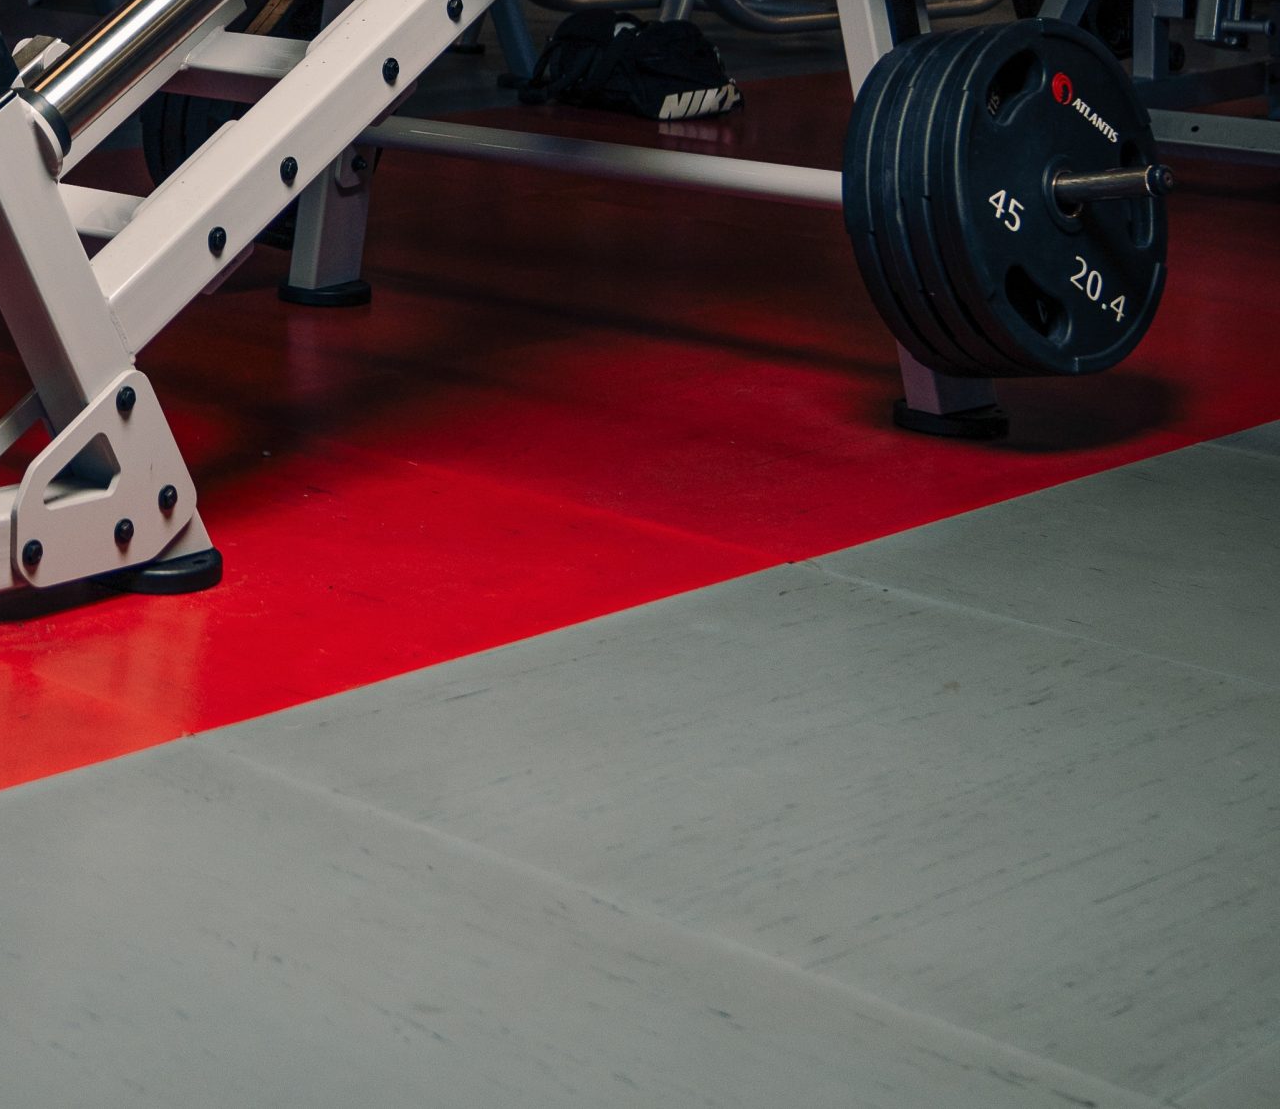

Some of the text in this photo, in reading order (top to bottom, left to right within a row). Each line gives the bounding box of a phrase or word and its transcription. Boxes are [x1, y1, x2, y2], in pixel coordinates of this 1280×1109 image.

[1071, 97, 1119, 144] ATLANTIS
[988, 189, 1025, 232] 45
[1070, 255, 1126, 322] 20.4
